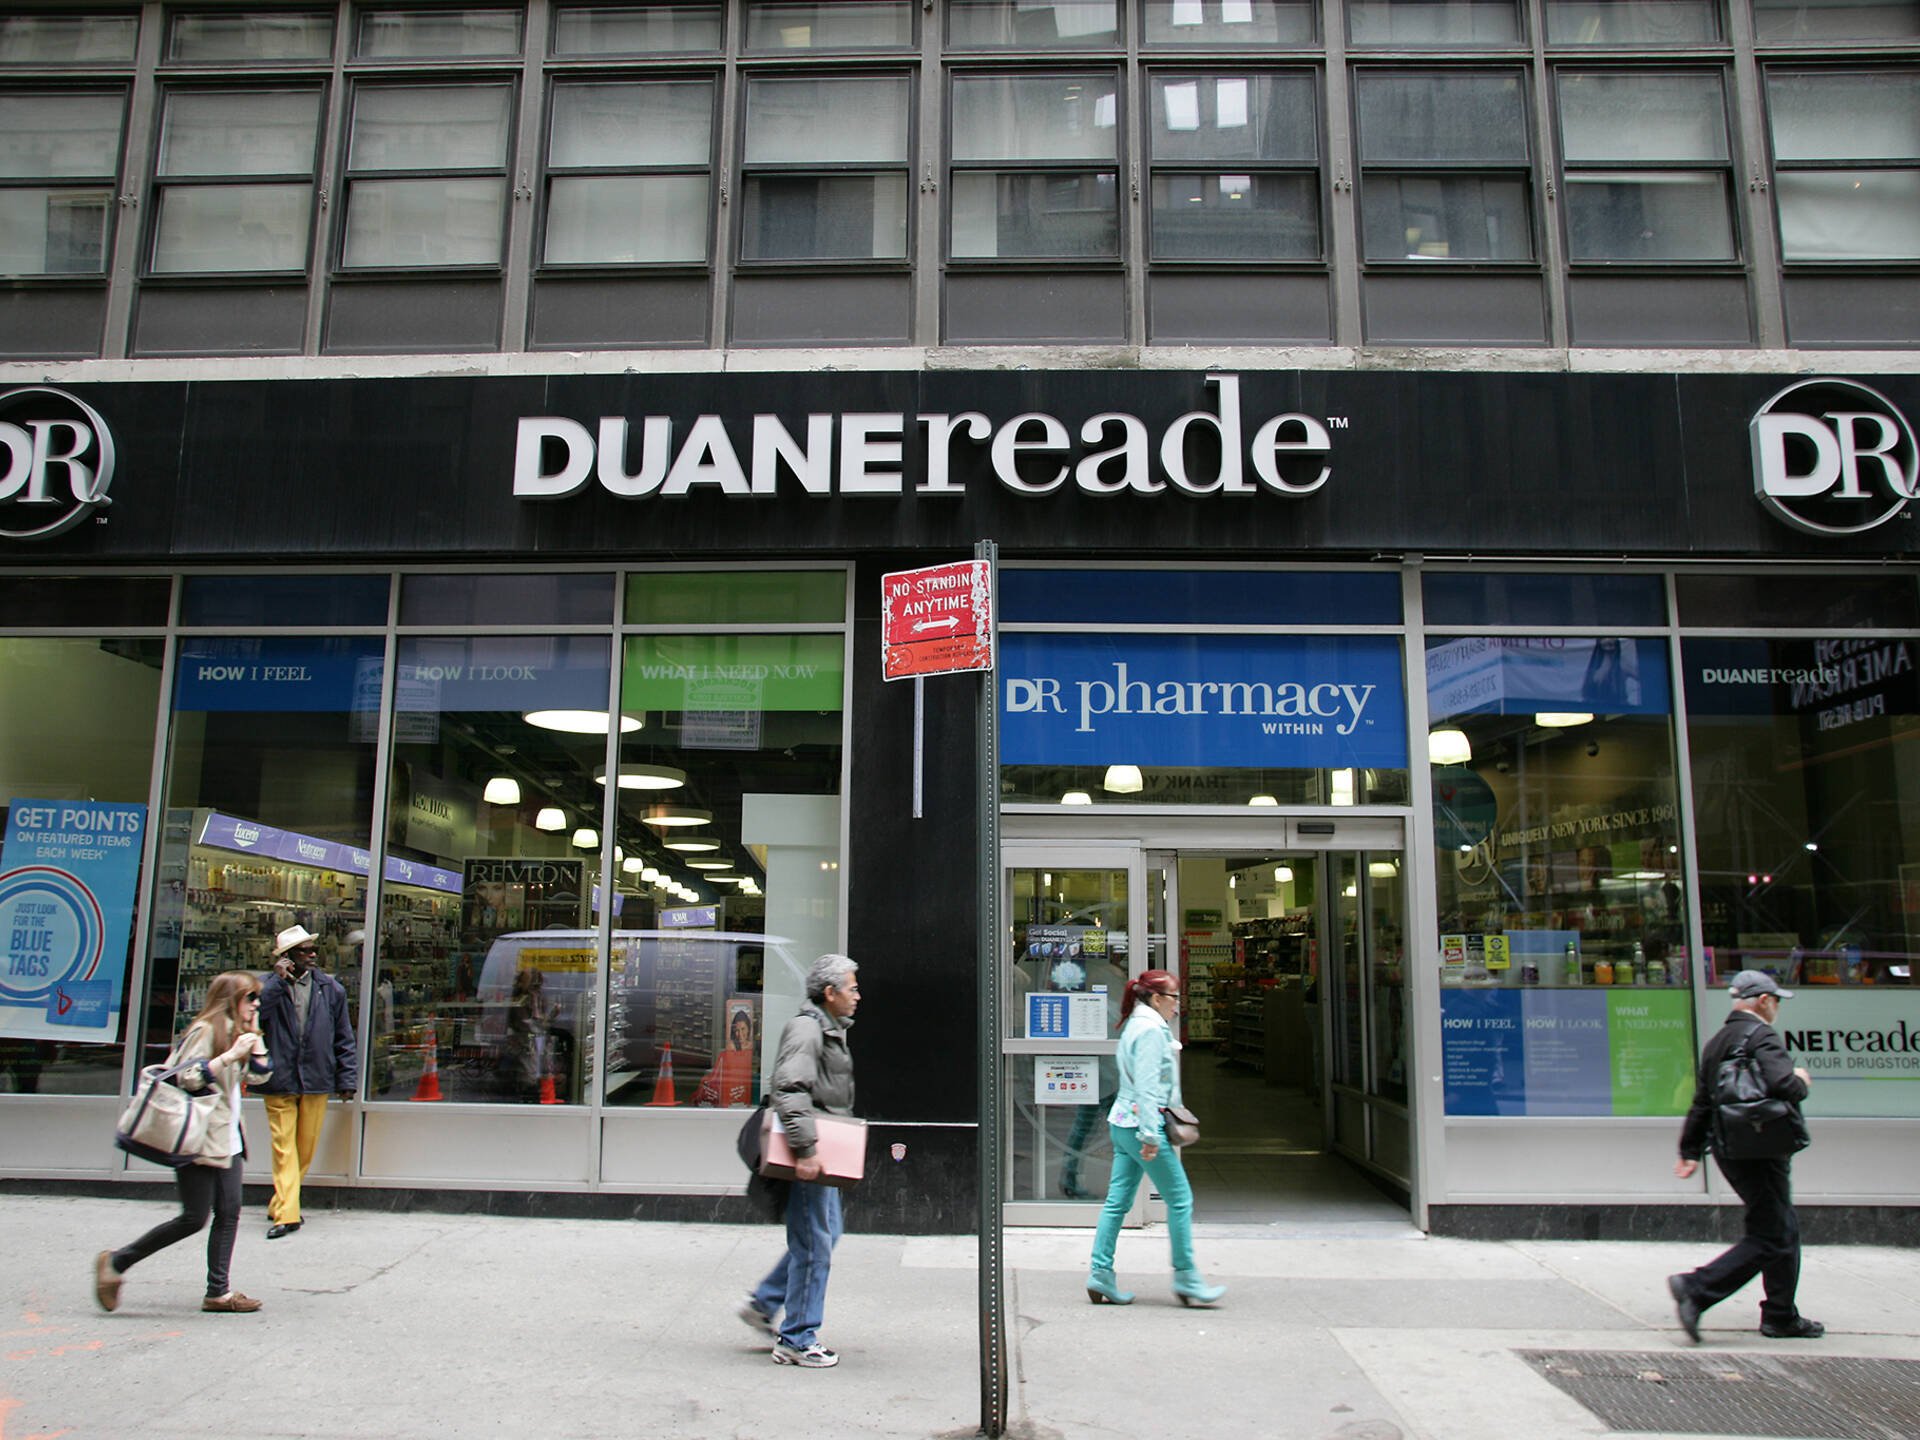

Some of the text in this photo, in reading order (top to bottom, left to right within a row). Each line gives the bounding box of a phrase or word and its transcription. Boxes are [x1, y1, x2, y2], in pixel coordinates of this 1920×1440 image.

[1757, 412, 1920, 499] DR
[892, 583, 910, 597] NO
[903, 594, 969, 616] ANYTIME
[199, 666, 312, 681] HOW I FEEL
[415, 666, 537, 681] HOW I LOOK
[641, 664, 819, 680] WHAT I NEED NOW
[1006, 678, 1067, 713] DR
[1075, 662, 1377, 735] pharmacy
[1262, 723, 1323, 735] WITHIN
[15, 807, 139, 832] GET POINTS
[1502, 826, 1550, 847] UNIQUELY
[1552, 821, 1577, 840] NEW
[1578, 815, 1611, 835] YORK
[1612, 808, 1650, 829] SINCE
[17, 831, 131, 847] ON FEATURED ITEMS
[36, 847, 66, 858] EACH
[470, 863, 578, 885] REVLON
[15, 903, 58, 915] JUST LOOK
[13, 916, 45, 927] FOR THE
[10, 929, 53, 951] BLUE
[8, 954, 50, 977] TAGS
[1615, 1006, 1650, 1016] WHAT
[1443, 1018, 1473, 1029] HOW
[1484, 1019, 1516, 1029] FEEL
[1526, 1018, 1557, 1029] HOW
[1567, 1018, 1603, 1029] LOOK
[1659, 1019, 1687, 1030] NOW
[1785, 1020, 1920, 1053] NEreade
[1805, 1057, 1841, 1069] YOUR
[1847, 1057, 1920, 1069] DRUGSTOR
